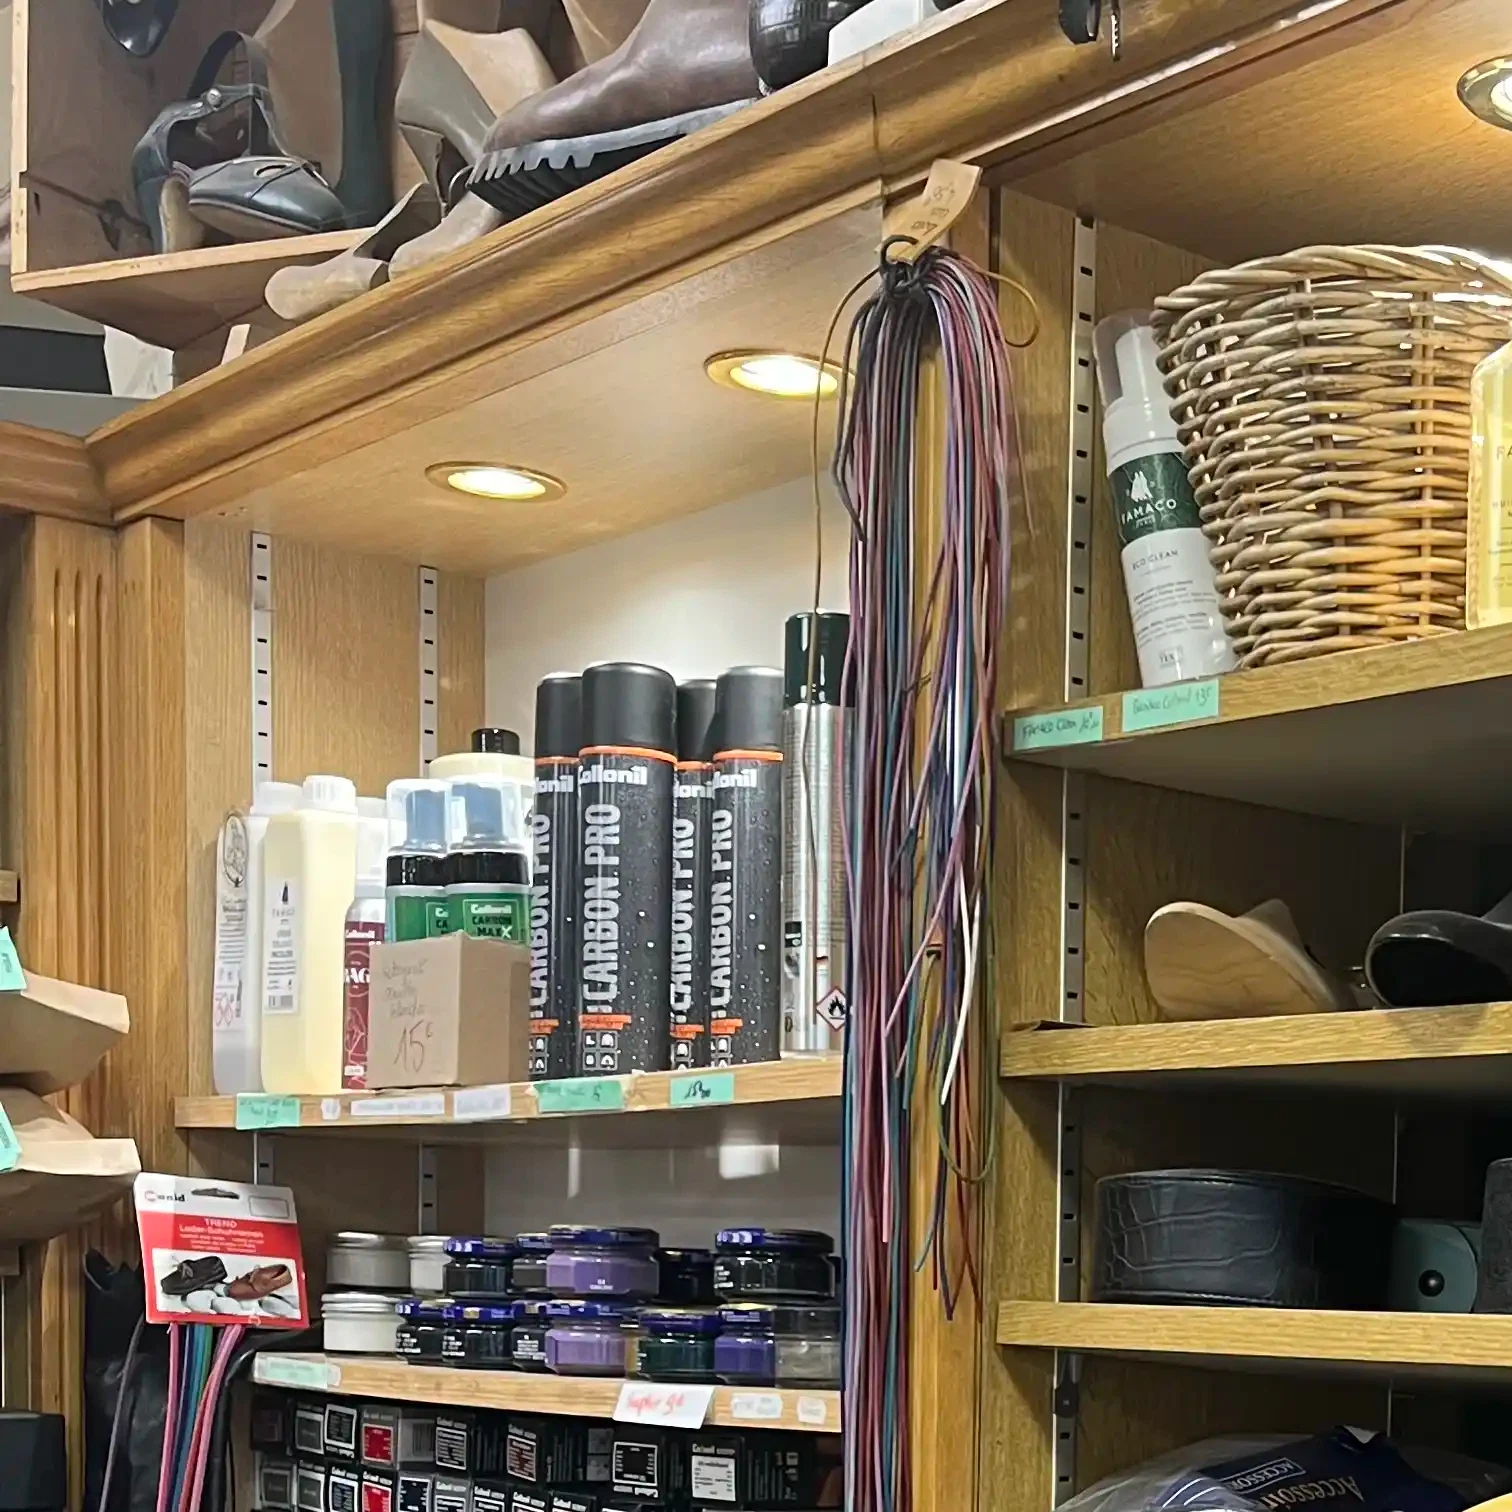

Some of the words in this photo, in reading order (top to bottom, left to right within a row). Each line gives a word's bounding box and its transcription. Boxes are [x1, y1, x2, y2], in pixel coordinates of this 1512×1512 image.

[1121, 499, 1177, 525] FAMACO
[585, 804, 621, 865] PRO
[711, 809, 733, 872] PRO
[583, 876, 620, 1000] CARBON
[710, 881, 733, 1007] CARBON
